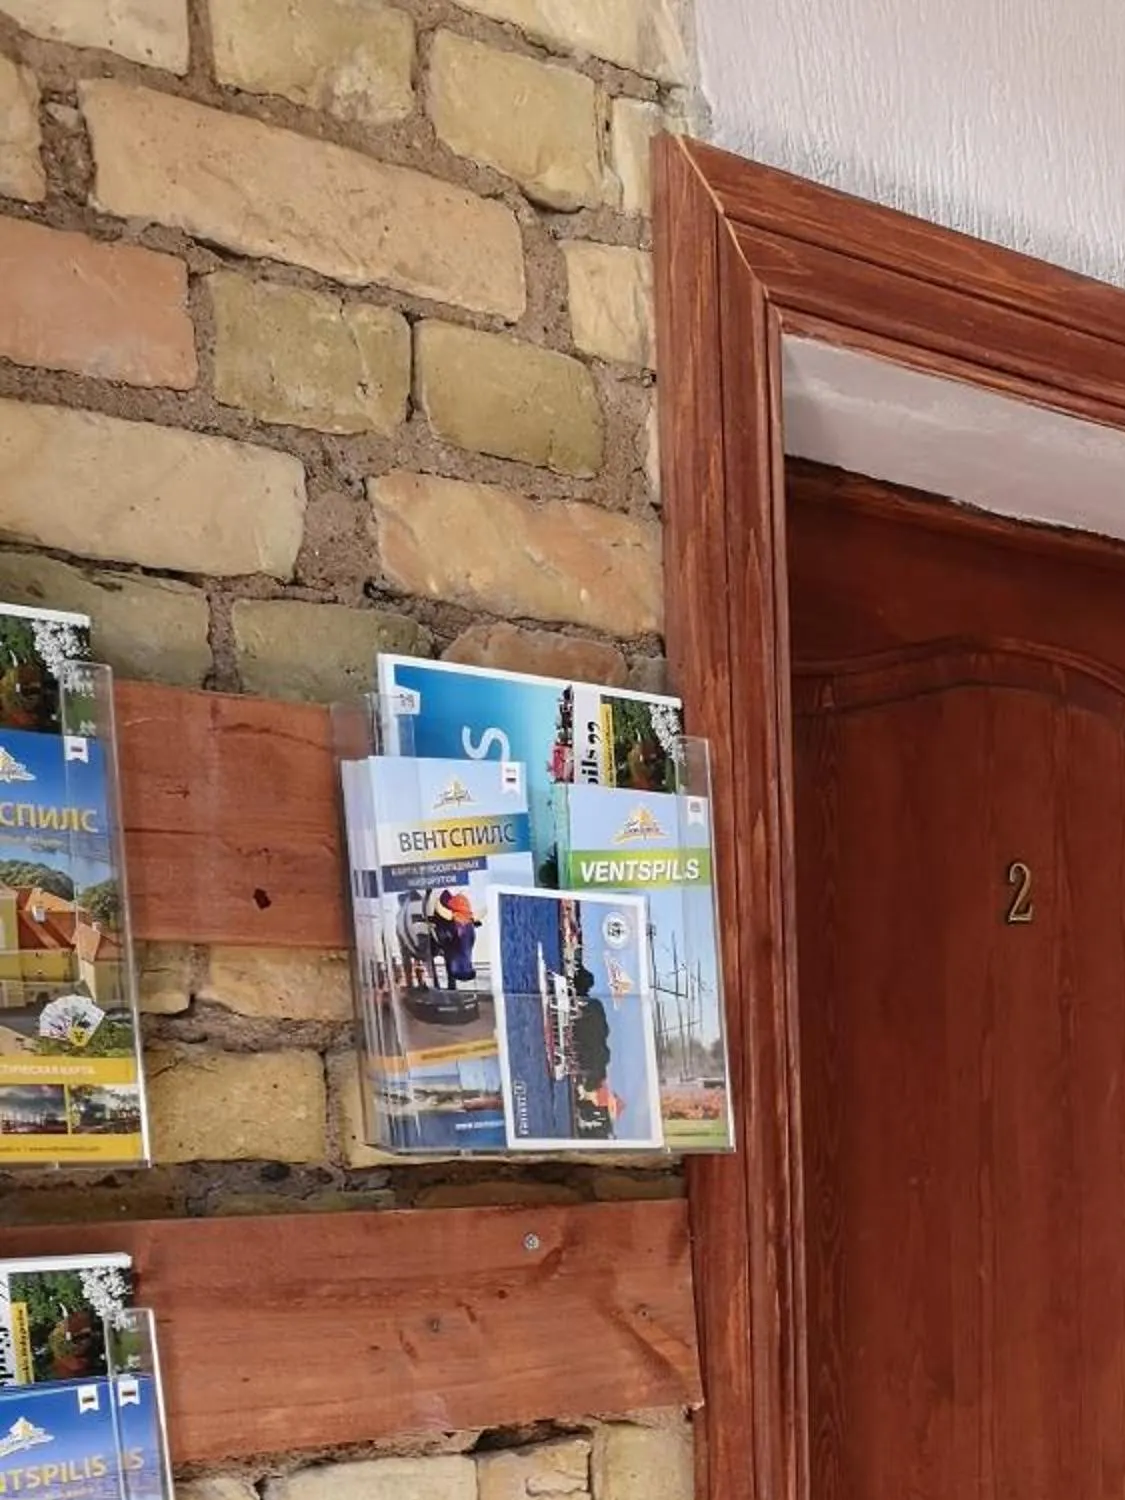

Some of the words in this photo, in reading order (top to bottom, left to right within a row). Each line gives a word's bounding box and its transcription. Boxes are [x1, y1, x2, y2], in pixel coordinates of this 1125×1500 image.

[398, 823, 517, 853] ВЕНТСПИЛС
[581, 858, 699, 883] VENTSPILS
[1008, 862, 1033, 922] 2
